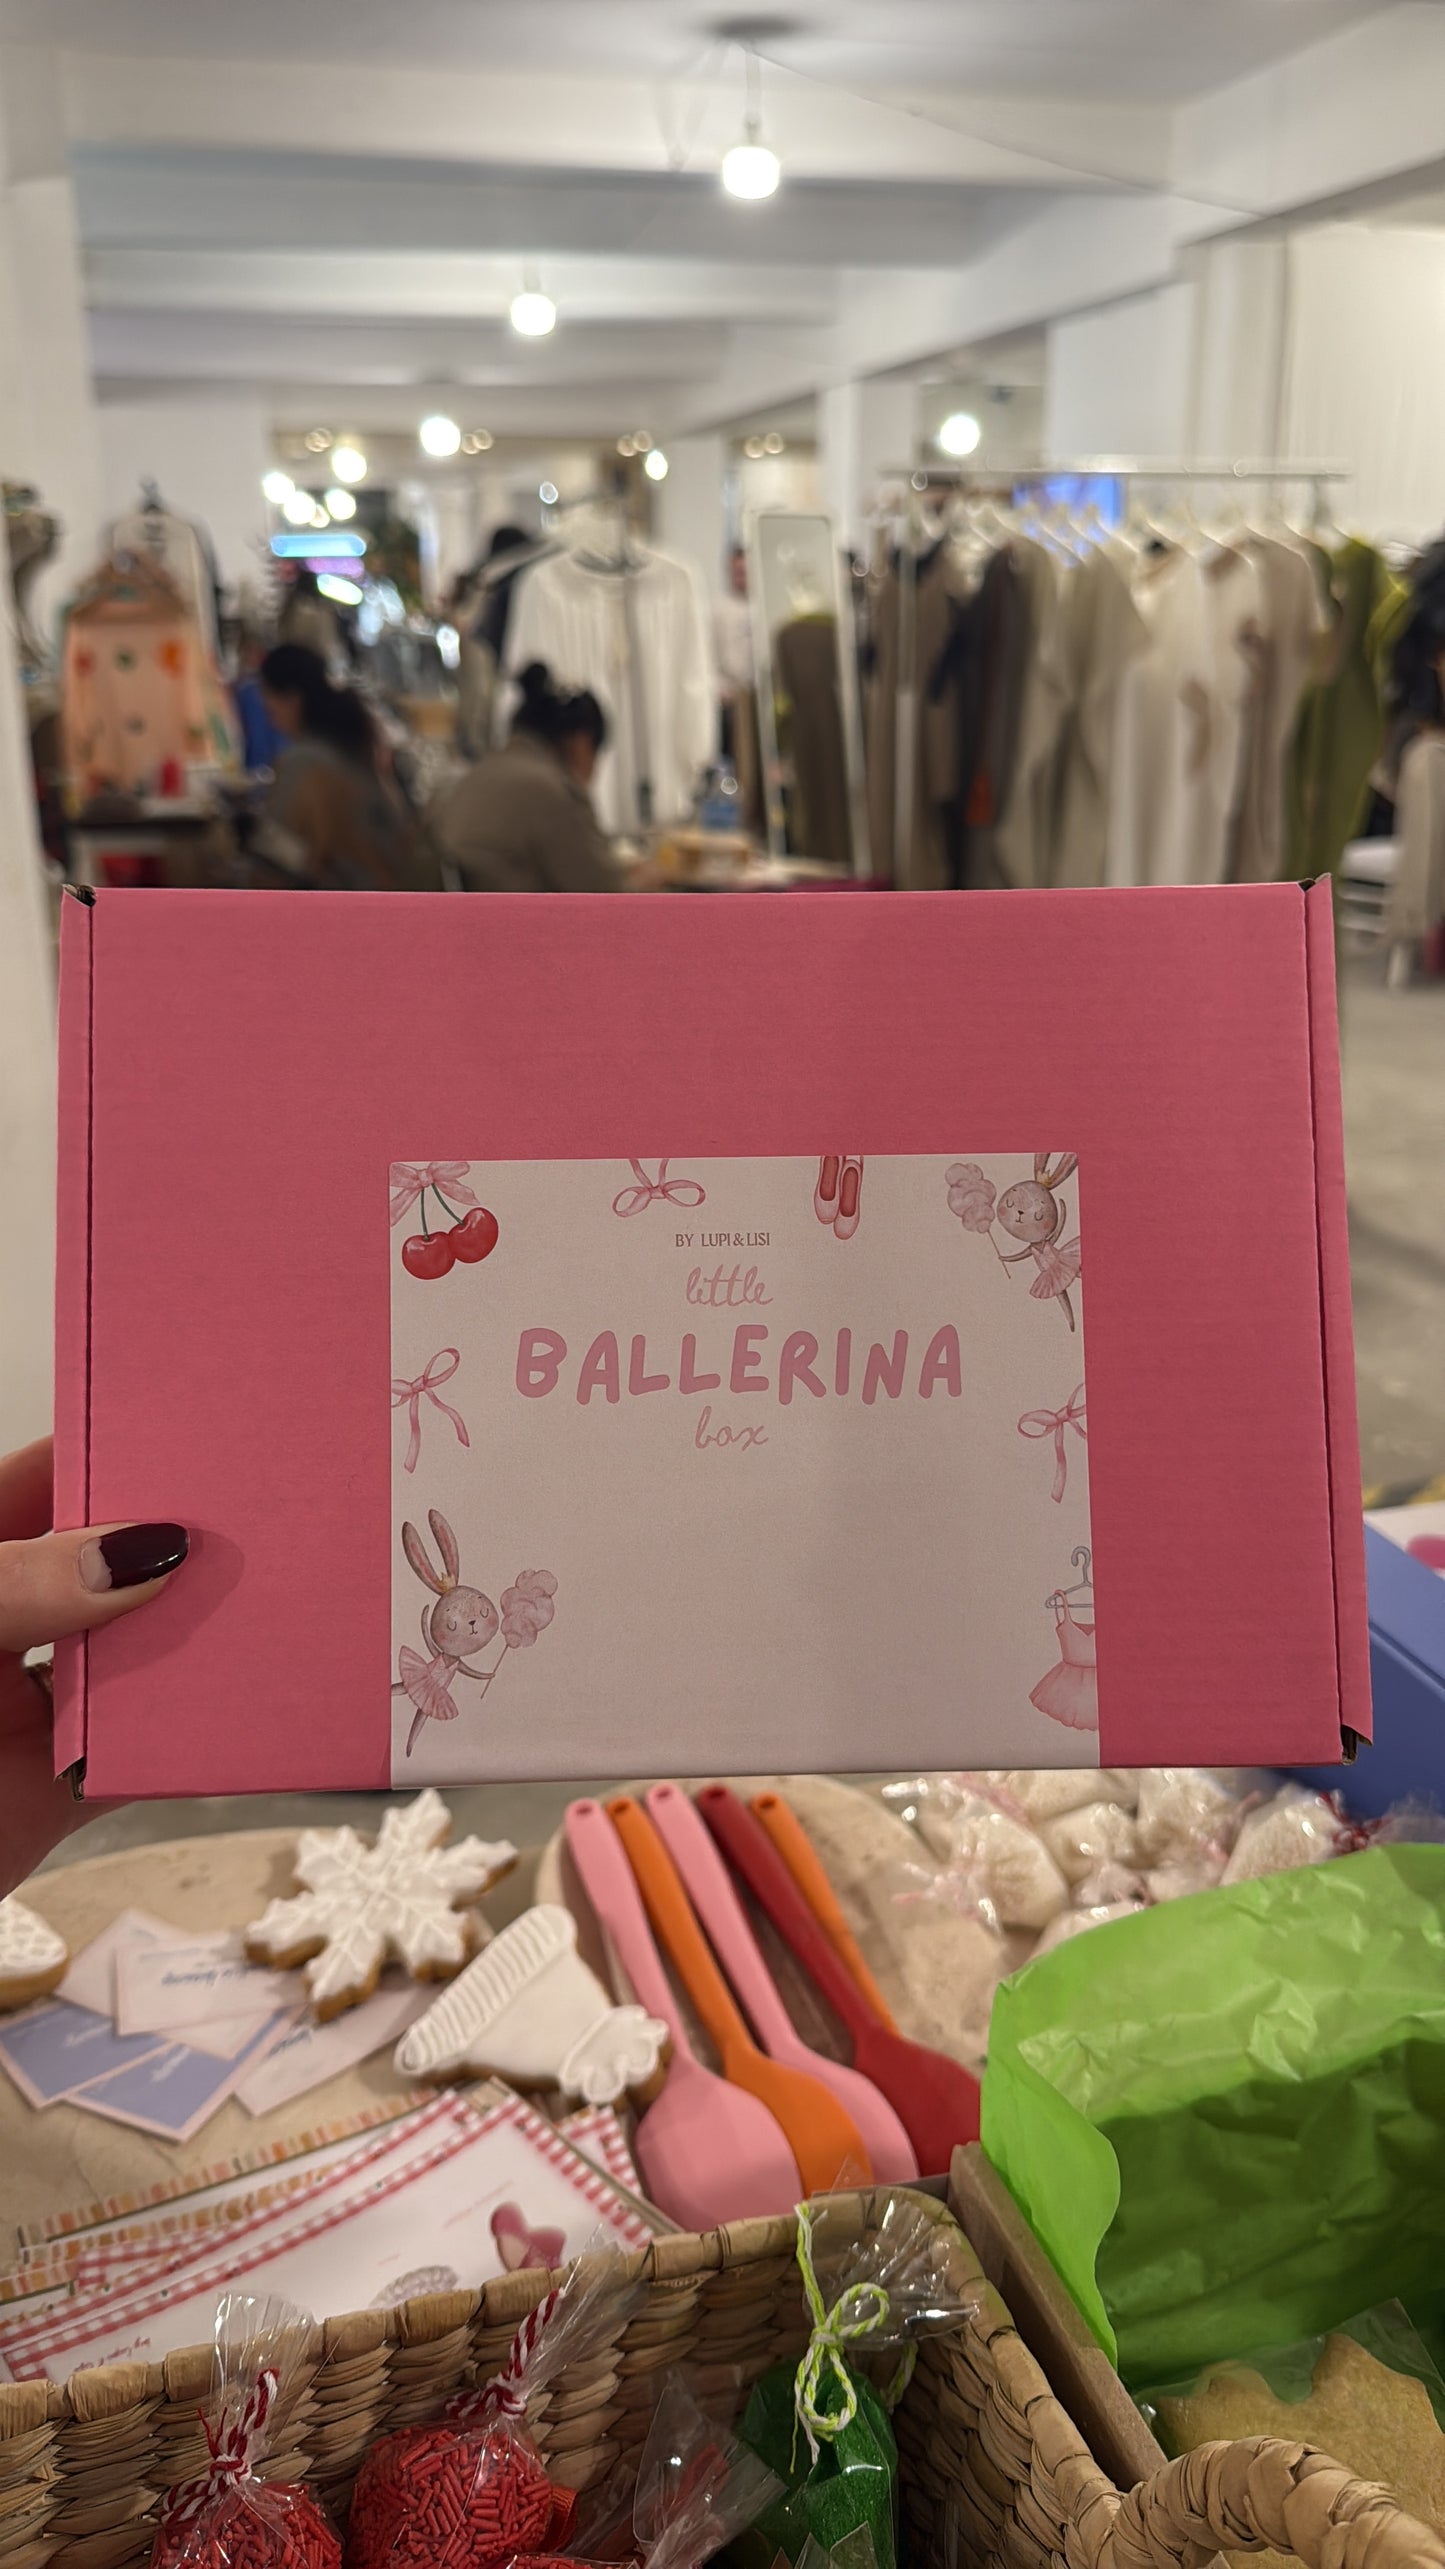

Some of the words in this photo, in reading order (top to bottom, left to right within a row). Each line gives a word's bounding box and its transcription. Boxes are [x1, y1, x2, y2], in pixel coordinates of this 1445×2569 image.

[675, 1233, 694, 1248] BY
[685, 1263, 774, 1308] little
[515, 1323, 963, 1406] BALLERINA
[694, 1405, 770, 1451] box
